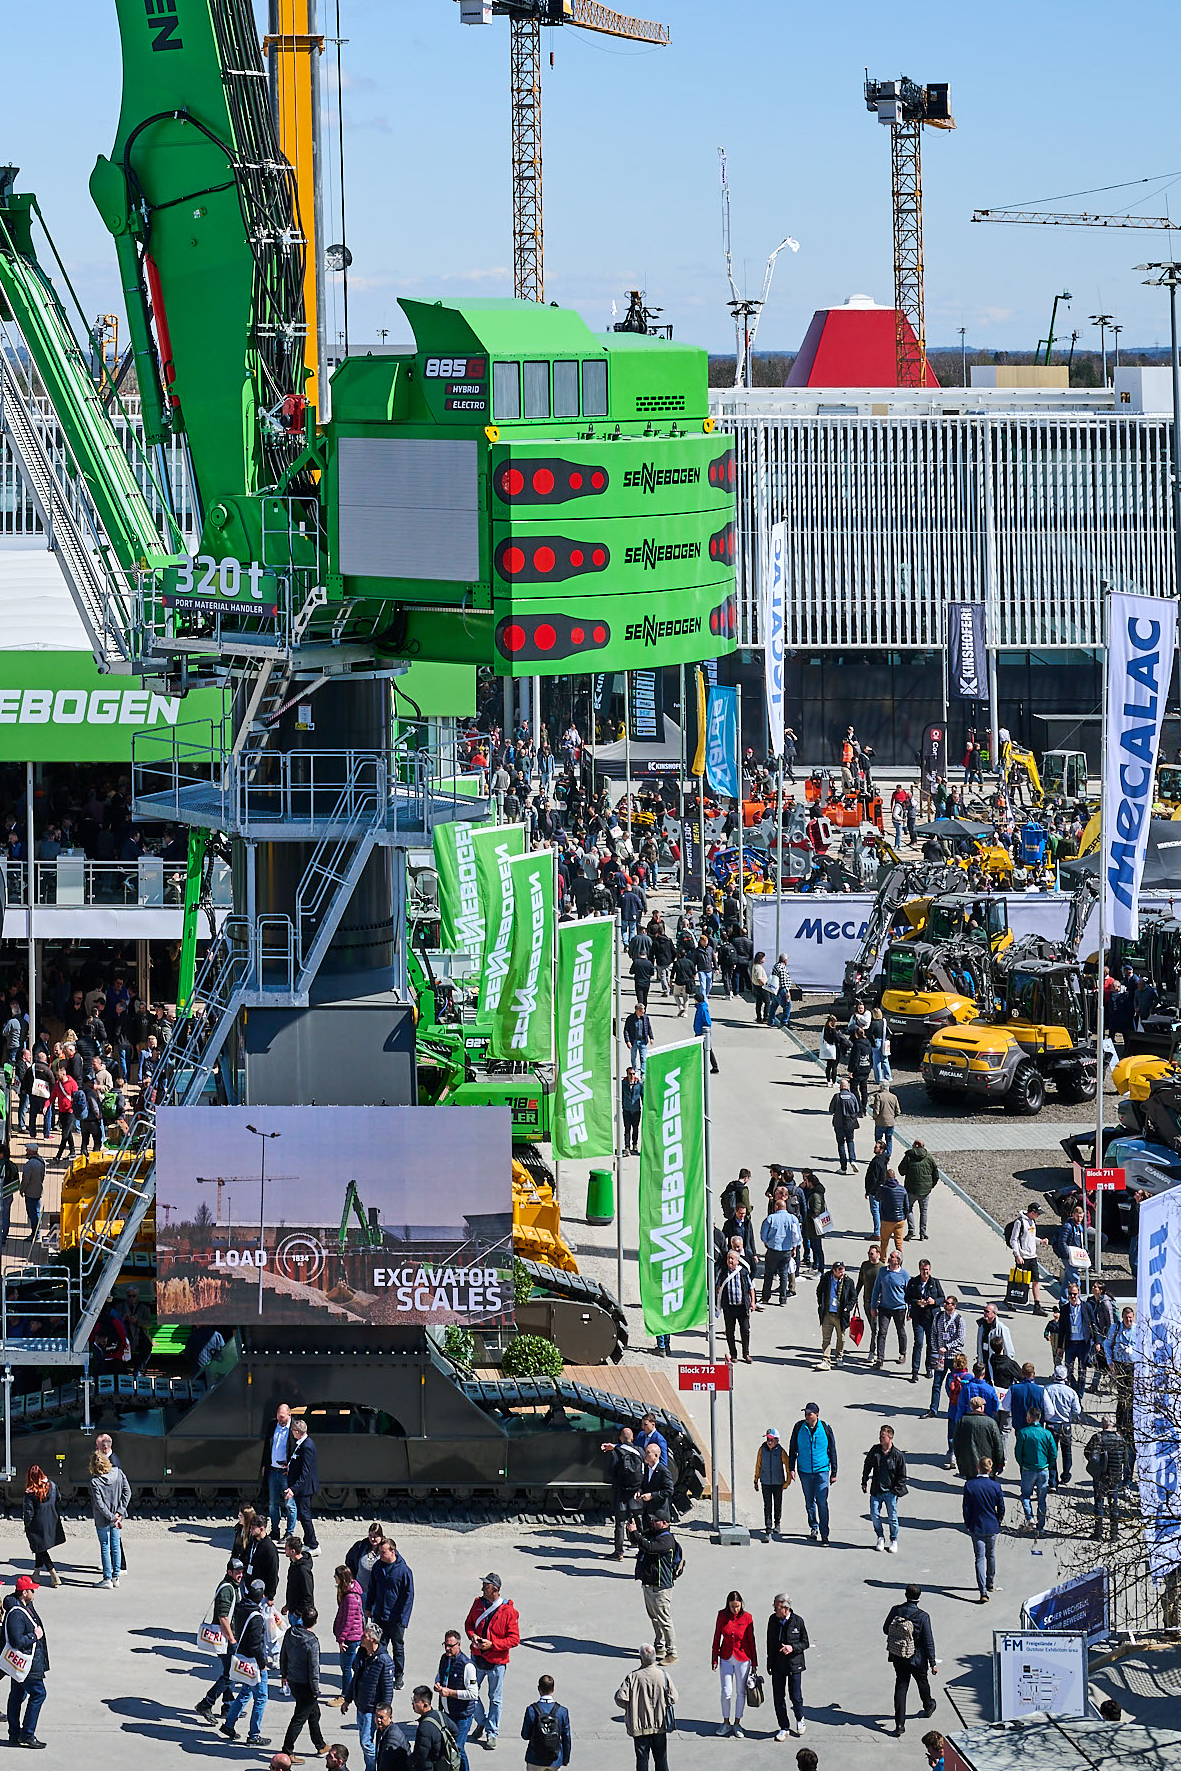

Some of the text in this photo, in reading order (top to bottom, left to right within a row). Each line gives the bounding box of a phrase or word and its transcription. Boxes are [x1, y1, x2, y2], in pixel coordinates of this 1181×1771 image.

[452, 385, 480, 394] HYBRID
[452, 400, 485, 409] ELECTRO
[623, 462, 701, 494] SENNEBOGEN
[624, 538, 701, 570] SENNEBOGEN
[175, 553, 264, 599] 320 t
[175, 598, 263, 614] PORT MATERIAL HANDLER
[624, 615, 702, 647] SENNEBOGEN
[960, 612, 975, 678] KINSHOFER
[1086, 1169, 1102, 1177] Block
[215, 1250, 267, 1267] LOAD
[373, 1268, 499, 1286] EXCAVATOR
[396, 1287, 502, 1311] SCALES
[679, 1365, 716, 1374] Block 712
[1004, 1639, 1023, 1652] FM
[4, 1649, 29, 1665] PERI
